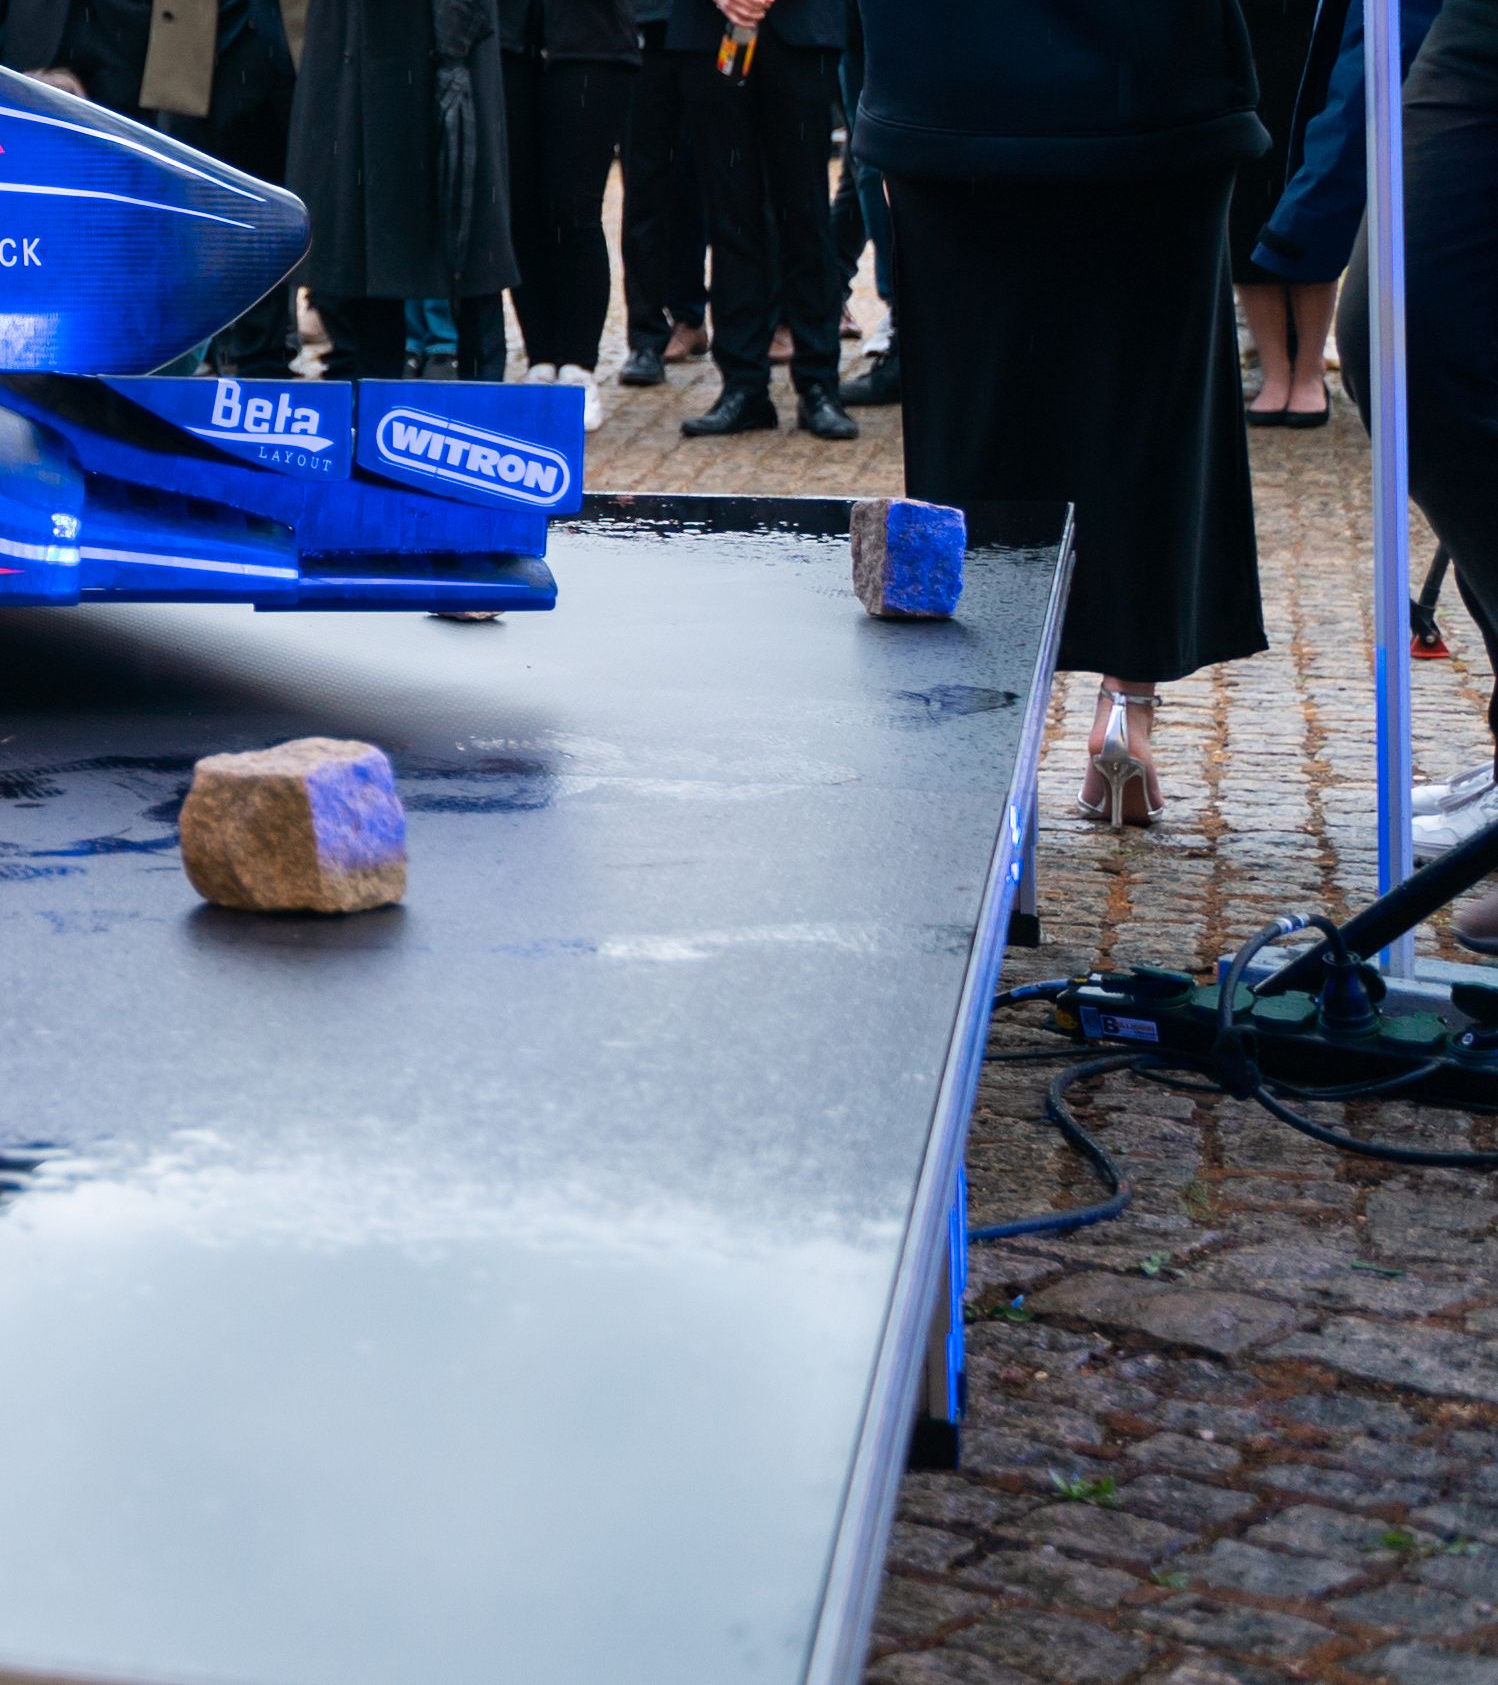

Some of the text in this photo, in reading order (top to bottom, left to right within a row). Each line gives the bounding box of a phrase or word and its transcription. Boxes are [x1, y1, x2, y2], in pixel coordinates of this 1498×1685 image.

[211, 377, 320, 435] Beta
[258, 446, 334, 473] LAYOUT
[390, 420, 558, 494] WITRON
